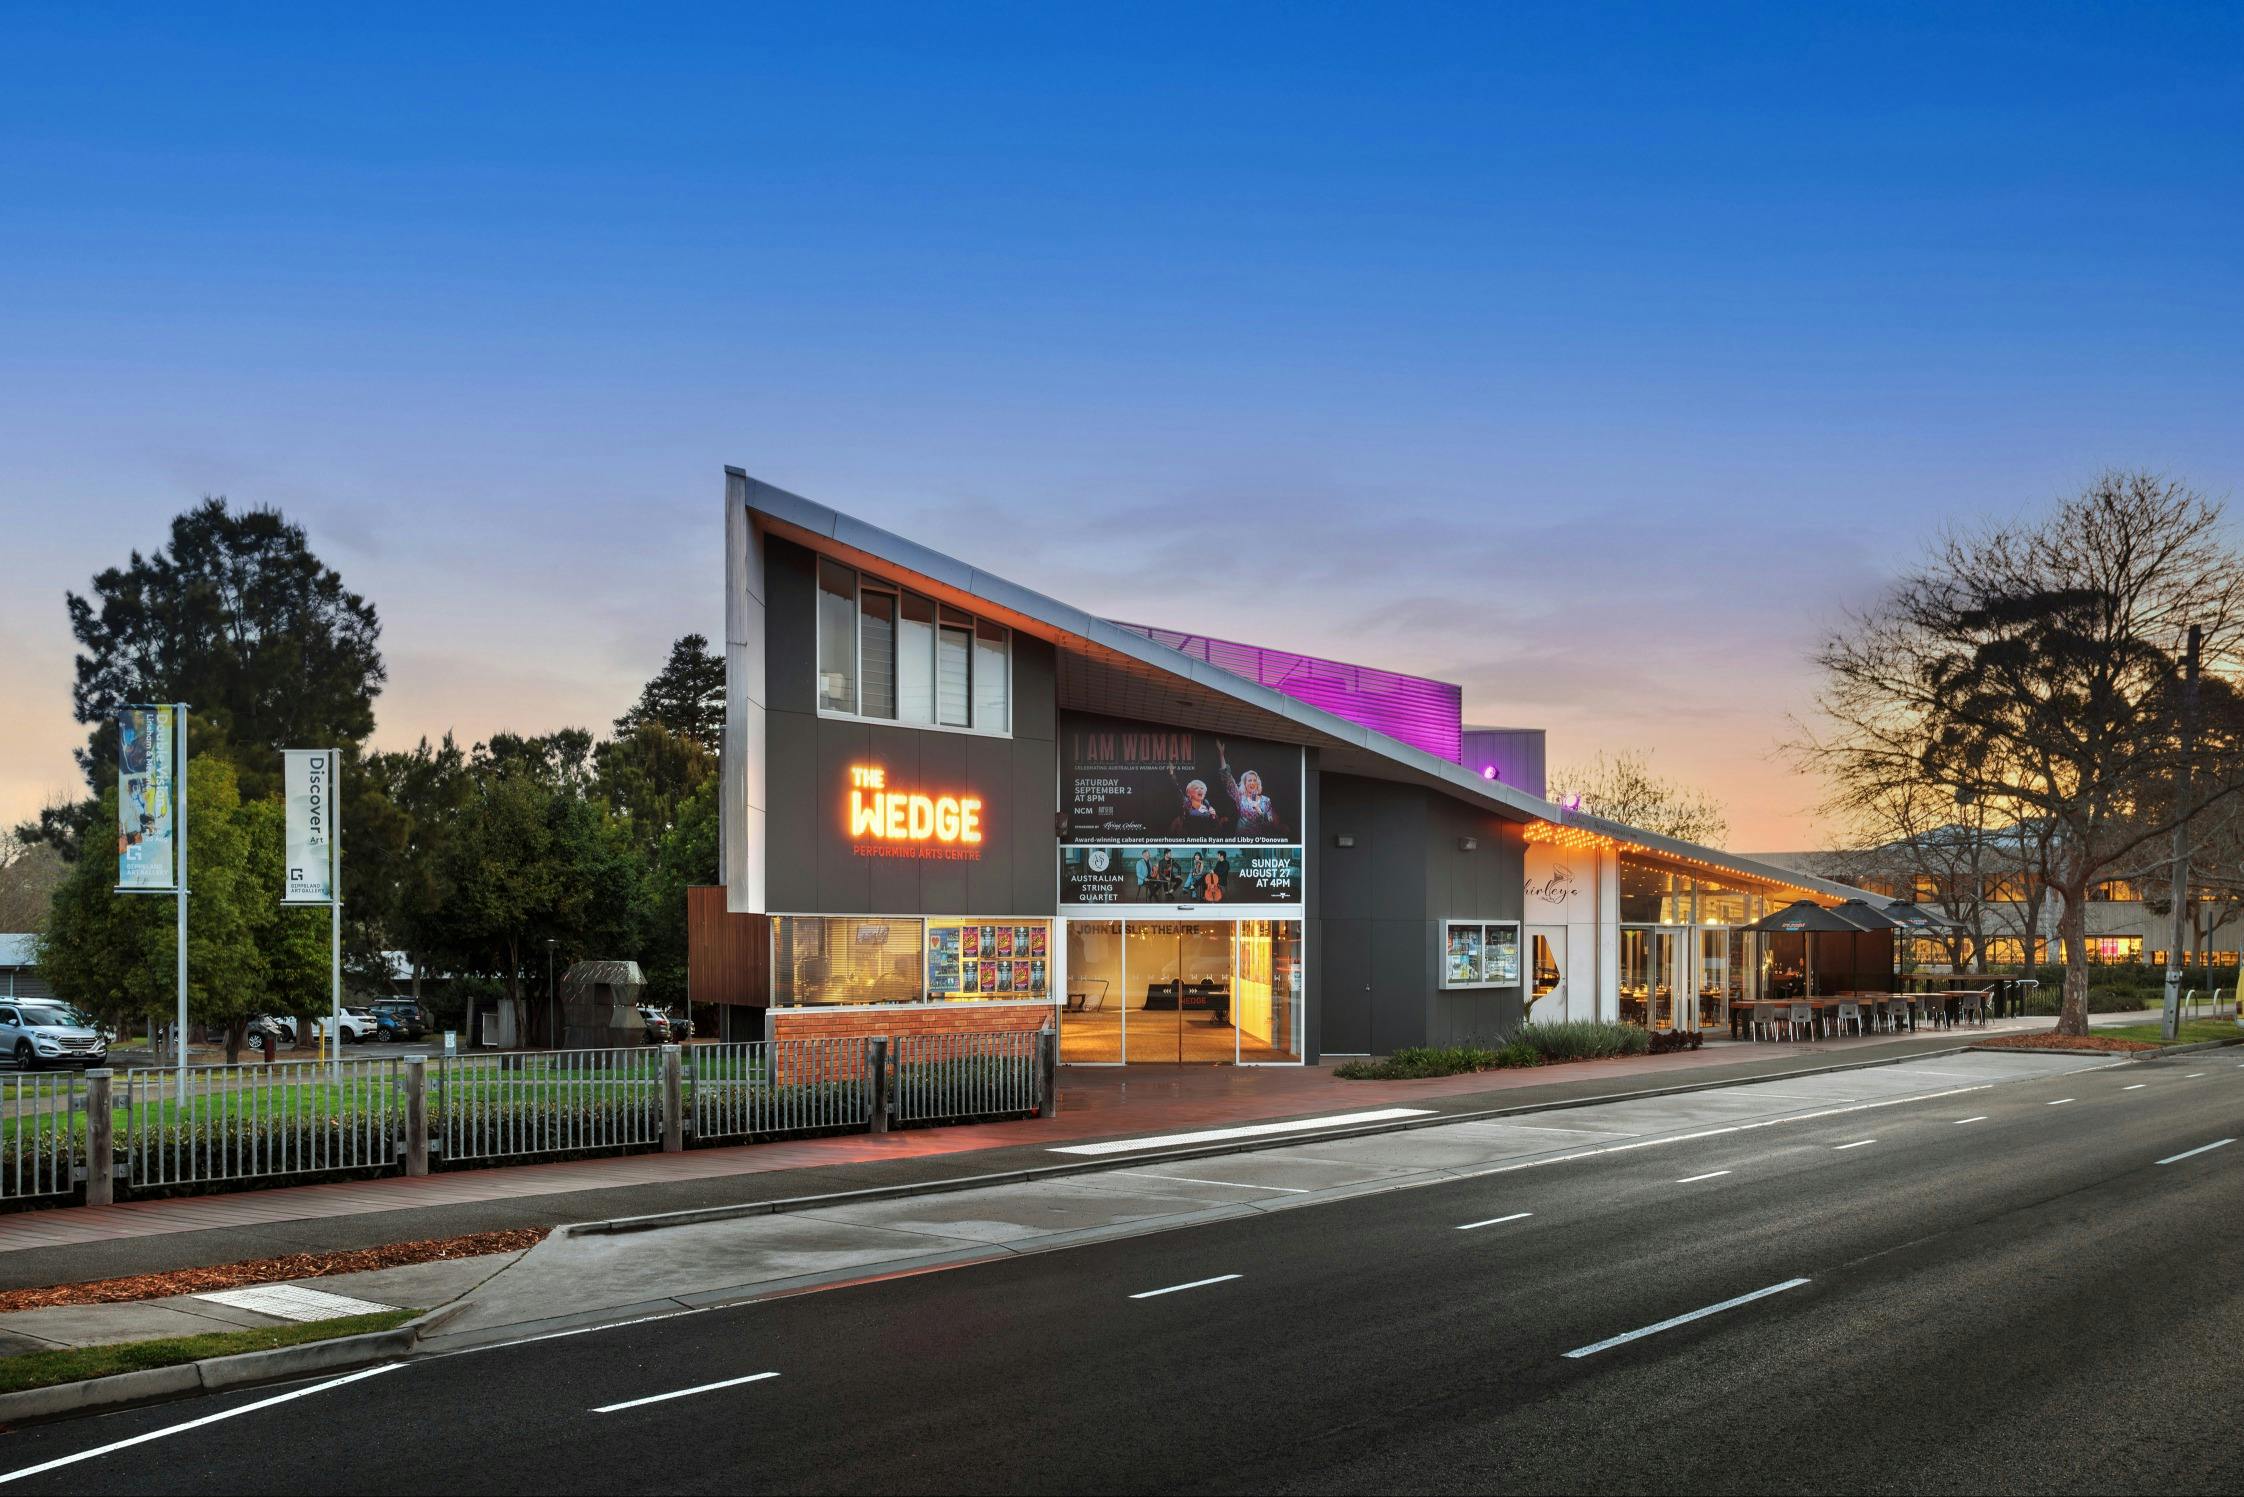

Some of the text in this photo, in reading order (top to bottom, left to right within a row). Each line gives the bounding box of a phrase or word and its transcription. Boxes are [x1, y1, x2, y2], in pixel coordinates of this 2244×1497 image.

[1075, 734, 1192, 760] I AM WOMAN
[852, 767, 885, 789] THE
[310, 757, 324, 834] Discover
[852, 791, 982, 843] WEDGE
[854, 845, 981, 861] PERFORMING ARTS CENTRE
[1251, 859, 1291, 868] SUNDAY
[1239, 869, 1290, 878] AUGUST 27
[1256, 879, 1290, 888] AT 4PM
[1078, 924, 1108, 935] JOHN
[1152, 924, 1199, 935] THEATRE
